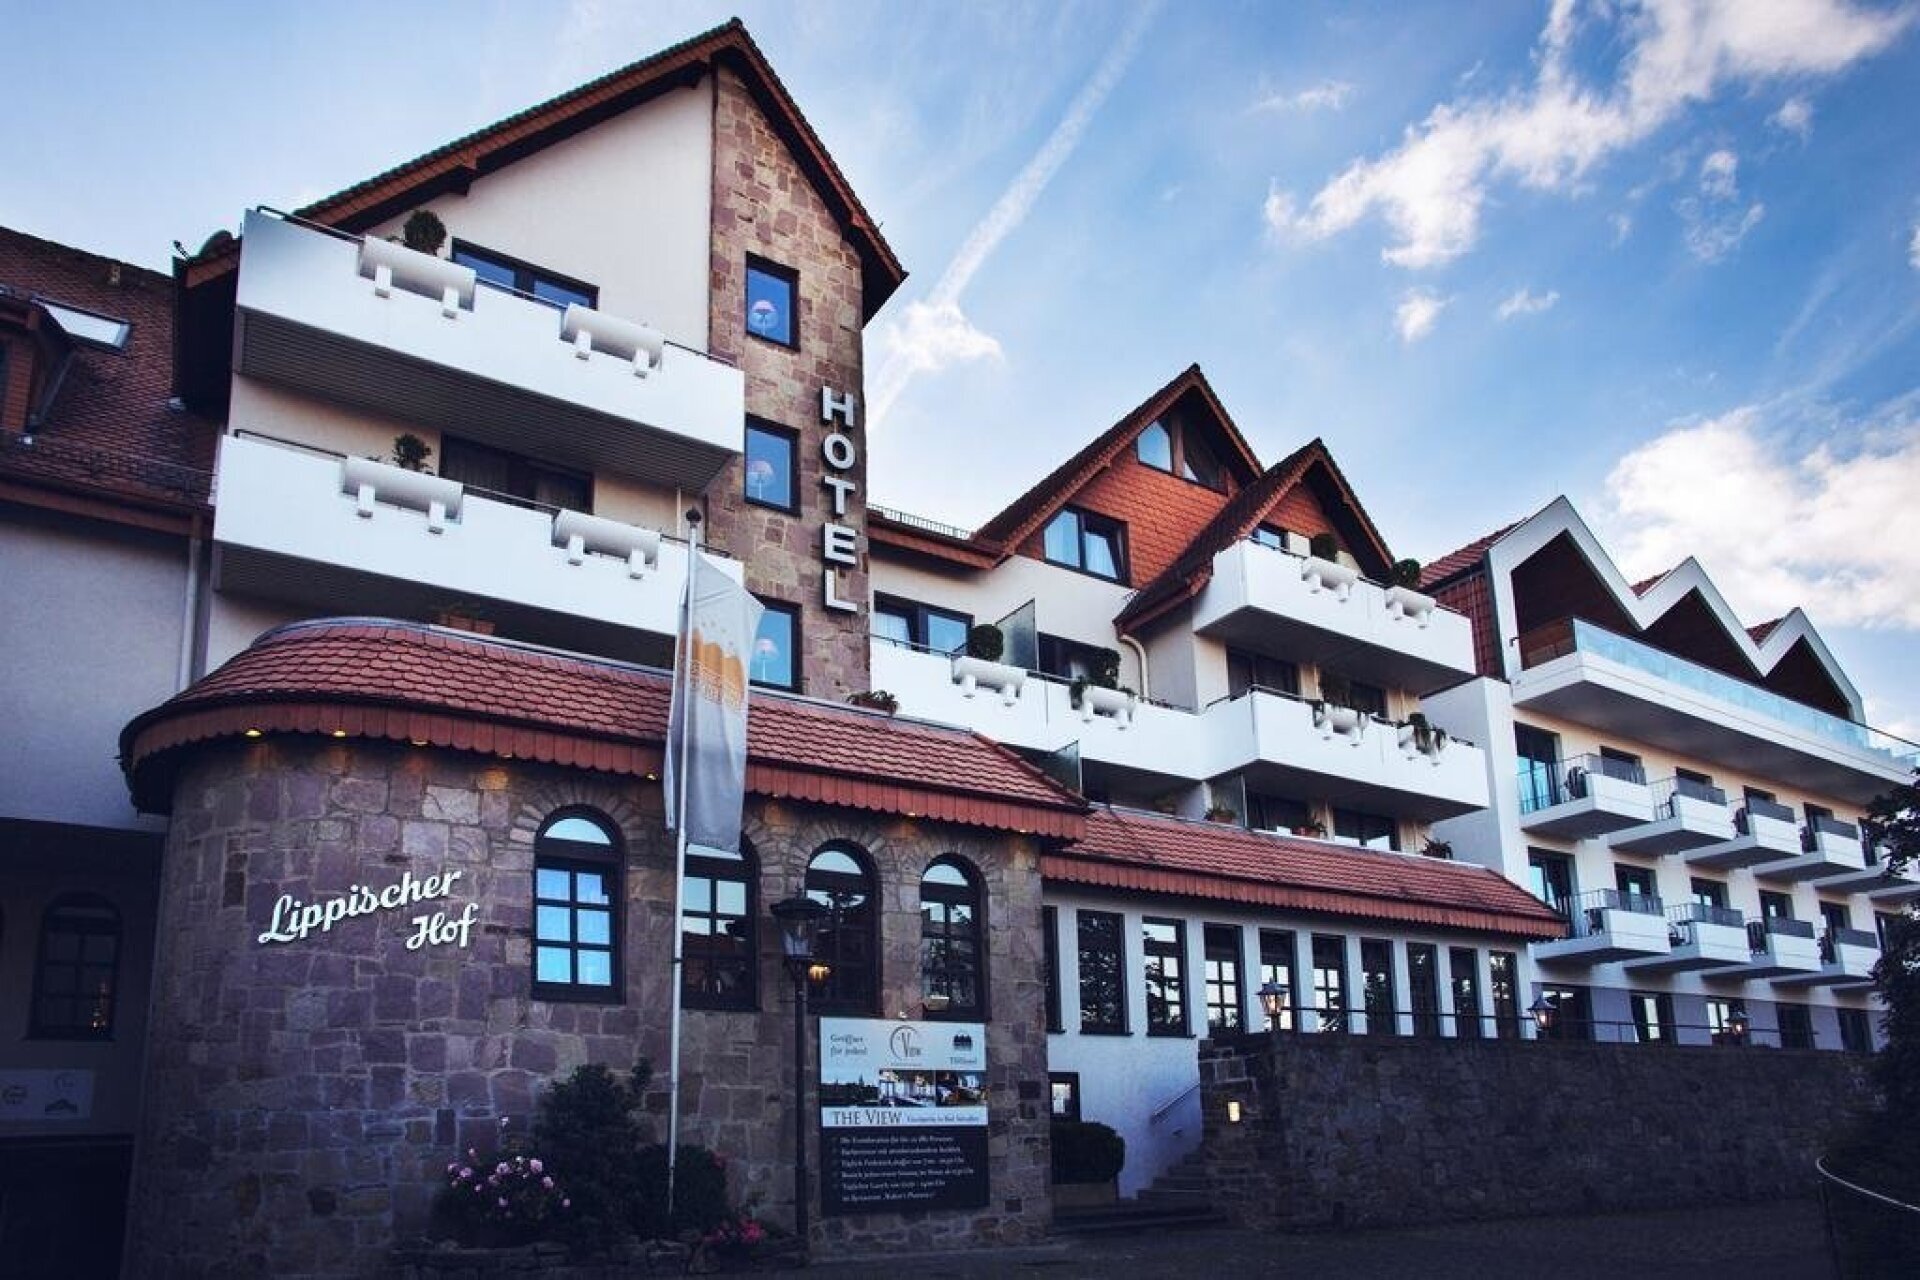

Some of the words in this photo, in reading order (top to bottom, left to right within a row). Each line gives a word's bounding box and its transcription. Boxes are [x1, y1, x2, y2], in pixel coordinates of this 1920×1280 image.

[822, 385, 858, 612] HOTEL
[258, 870, 462, 944] Lippischer
[406, 902, 479, 950] Hof
[833, 1110, 861, 1125] THE
